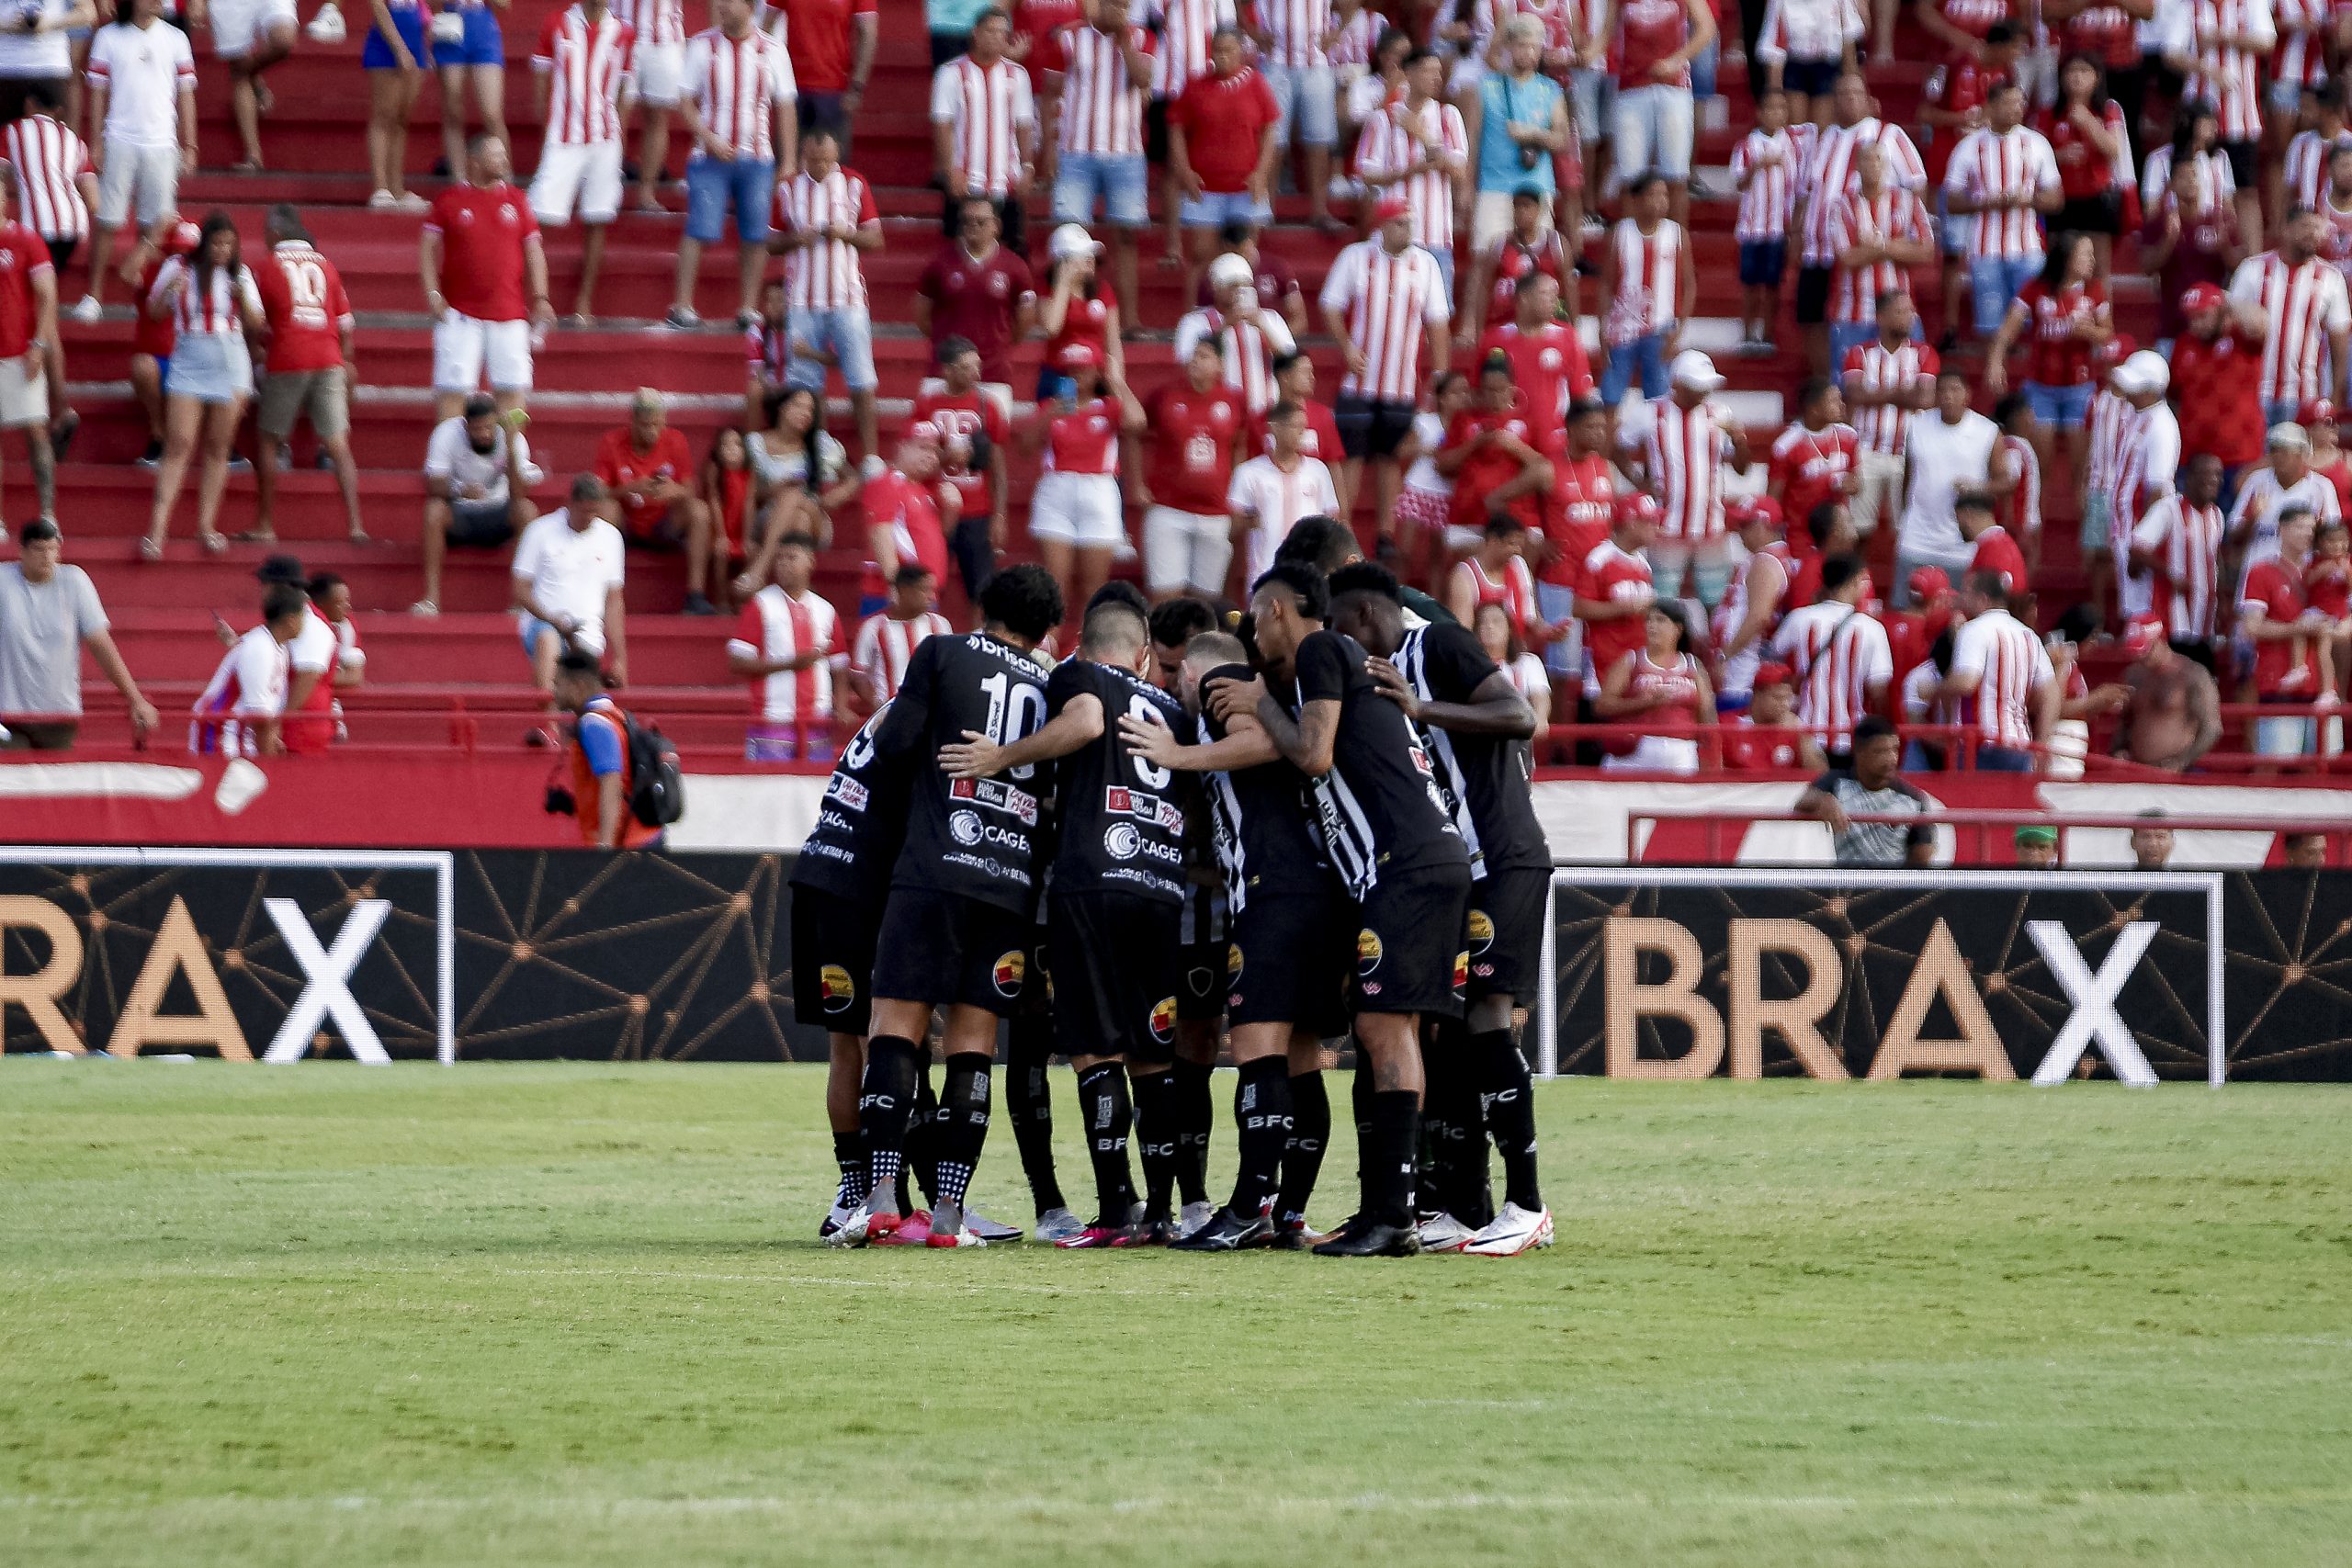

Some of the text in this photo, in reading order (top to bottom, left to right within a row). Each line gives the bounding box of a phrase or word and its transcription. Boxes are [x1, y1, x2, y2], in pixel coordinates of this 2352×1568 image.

[980, 671, 1047, 779] 10
[985, 826, 1031, 853] CAGE
[1604, 917, 2160, 1088] BRAX
[1247, 1115, 1294, 1130] BFC
